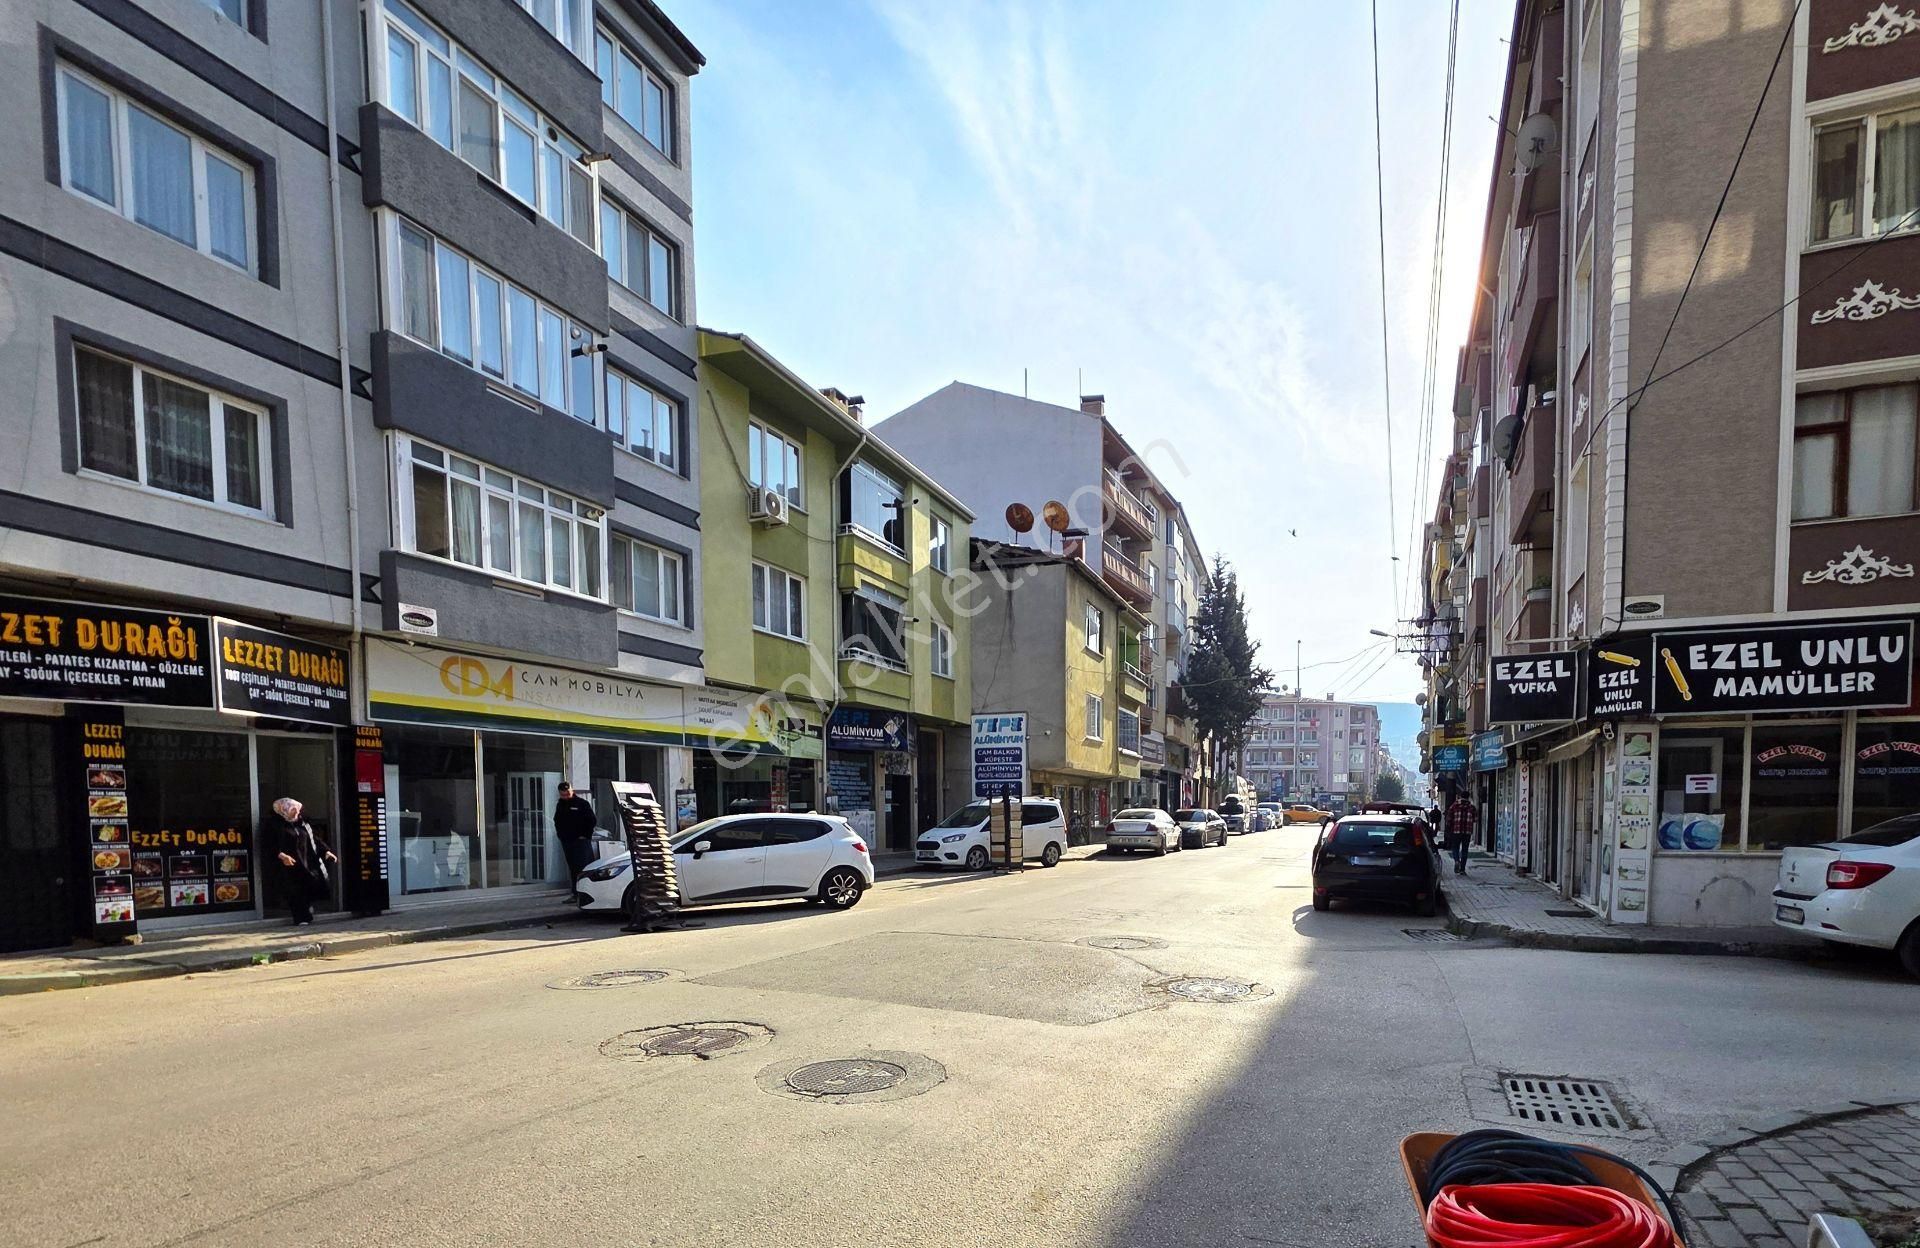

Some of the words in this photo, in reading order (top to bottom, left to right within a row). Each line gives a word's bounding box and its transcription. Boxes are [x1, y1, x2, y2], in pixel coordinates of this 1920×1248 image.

[76, 616, 198, 661] DURAĞI
[1689, 641, 1782, 670] EZEL
[1800, 635, 1904, 667] UNLU
[45, 653, 91, 668] PATATES
[94, 657, 148, 672] KIZARTMA
[159, 661, 204, 676] GÖZLEME
[223, 636, 283, 673] LEZZET
[289, 649, 344, 687] DURAĞI
[1495, 659, 1571, 681] EZEL
[23, 666, 61, 682] SOĞUK
[64, 668, 121, 685] İÇECEKLER
[132, 675, 166, 688] AYRAN
[521, 671, 560, 687] CAN
[1598, 669, 1640, 689] EZEL
[1712, 670, 1876, 698] MAMÜLLER
[1508, 681, 1557, 695] YUFKA
[1604, 688, 1633, 702] UNLU
[1594, 700, 1643, 714] MAMÜLLER
[84, 722, 123, 739] LEZZET
[356, 726, 381, 737] LEZZET
[831, 725, 884, 738] ALÜMİNYUM
[974, 716, 1024, 733] TEPE
[356, 737, 382, 748] DURAĞI
[974, 734, 1024, 745] ALÜMİNYUM
[83, 742, 126, 759] DURAĞI
[1759, 746, 1787, 762] EZEL
[1788, 745, 1827, 762] YUFKA
[1859, 743, 1889, 759] EZEL
[186, 828, 242, 845] DURAĞI
